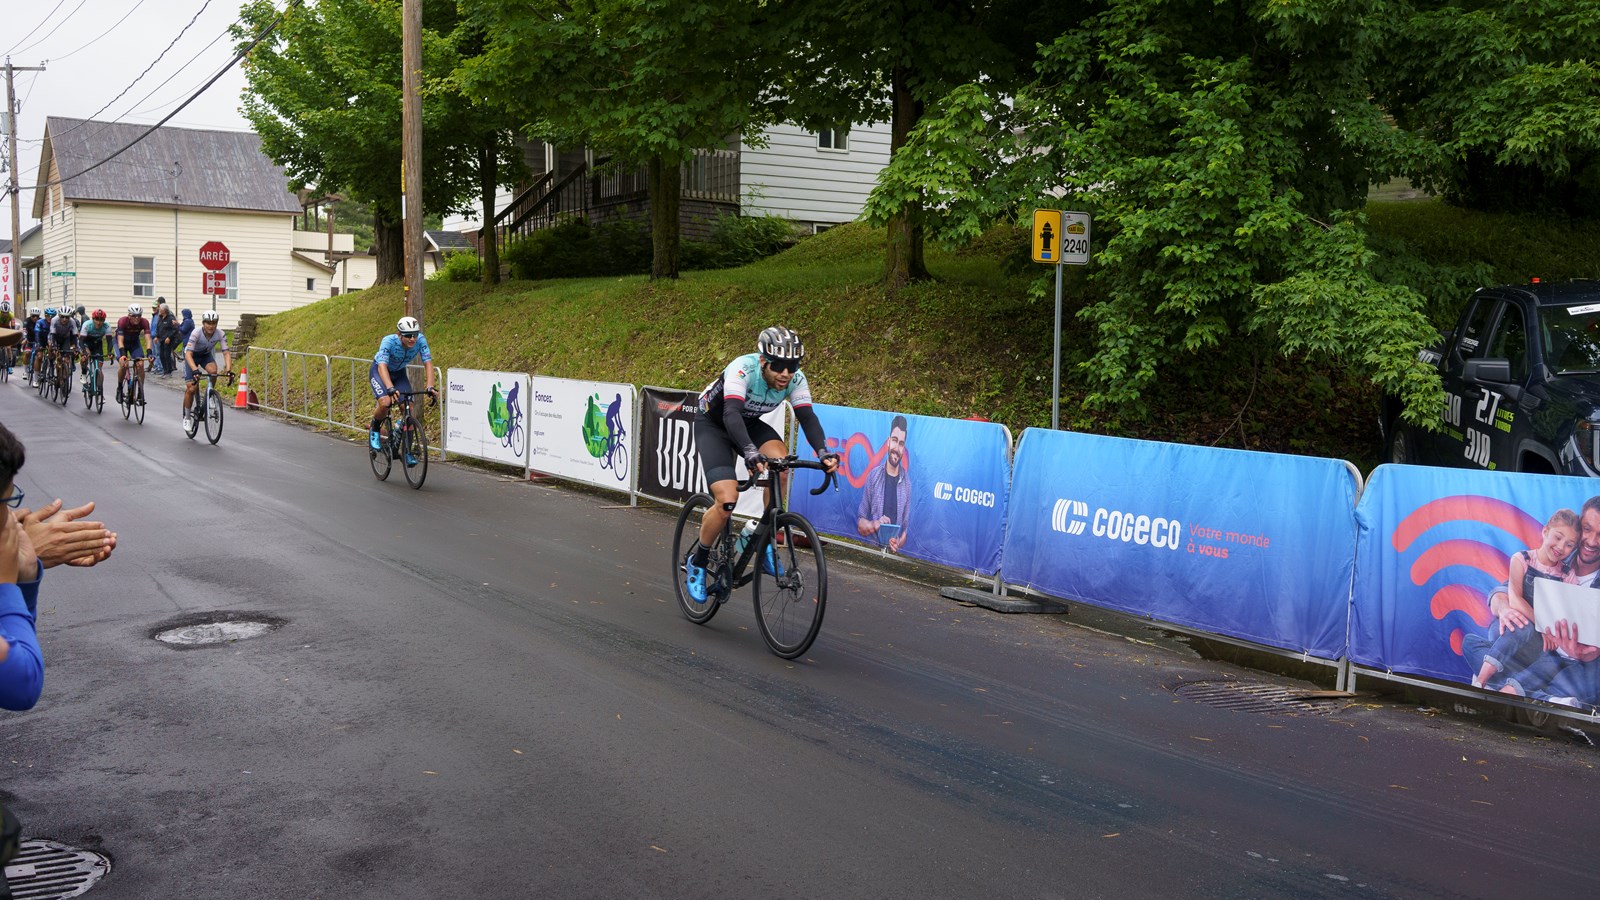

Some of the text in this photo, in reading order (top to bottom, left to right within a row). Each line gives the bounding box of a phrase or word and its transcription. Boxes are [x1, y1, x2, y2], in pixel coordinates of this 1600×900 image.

[200, 250, 229, 262] ARRÊT
[1064, 239, 1088, 254] 2240
[1475, 388, 1502, 426] 2.7
[1189, 522, 1271, 549] Votre monde
[1187, 538, 1230, 559] à vous
